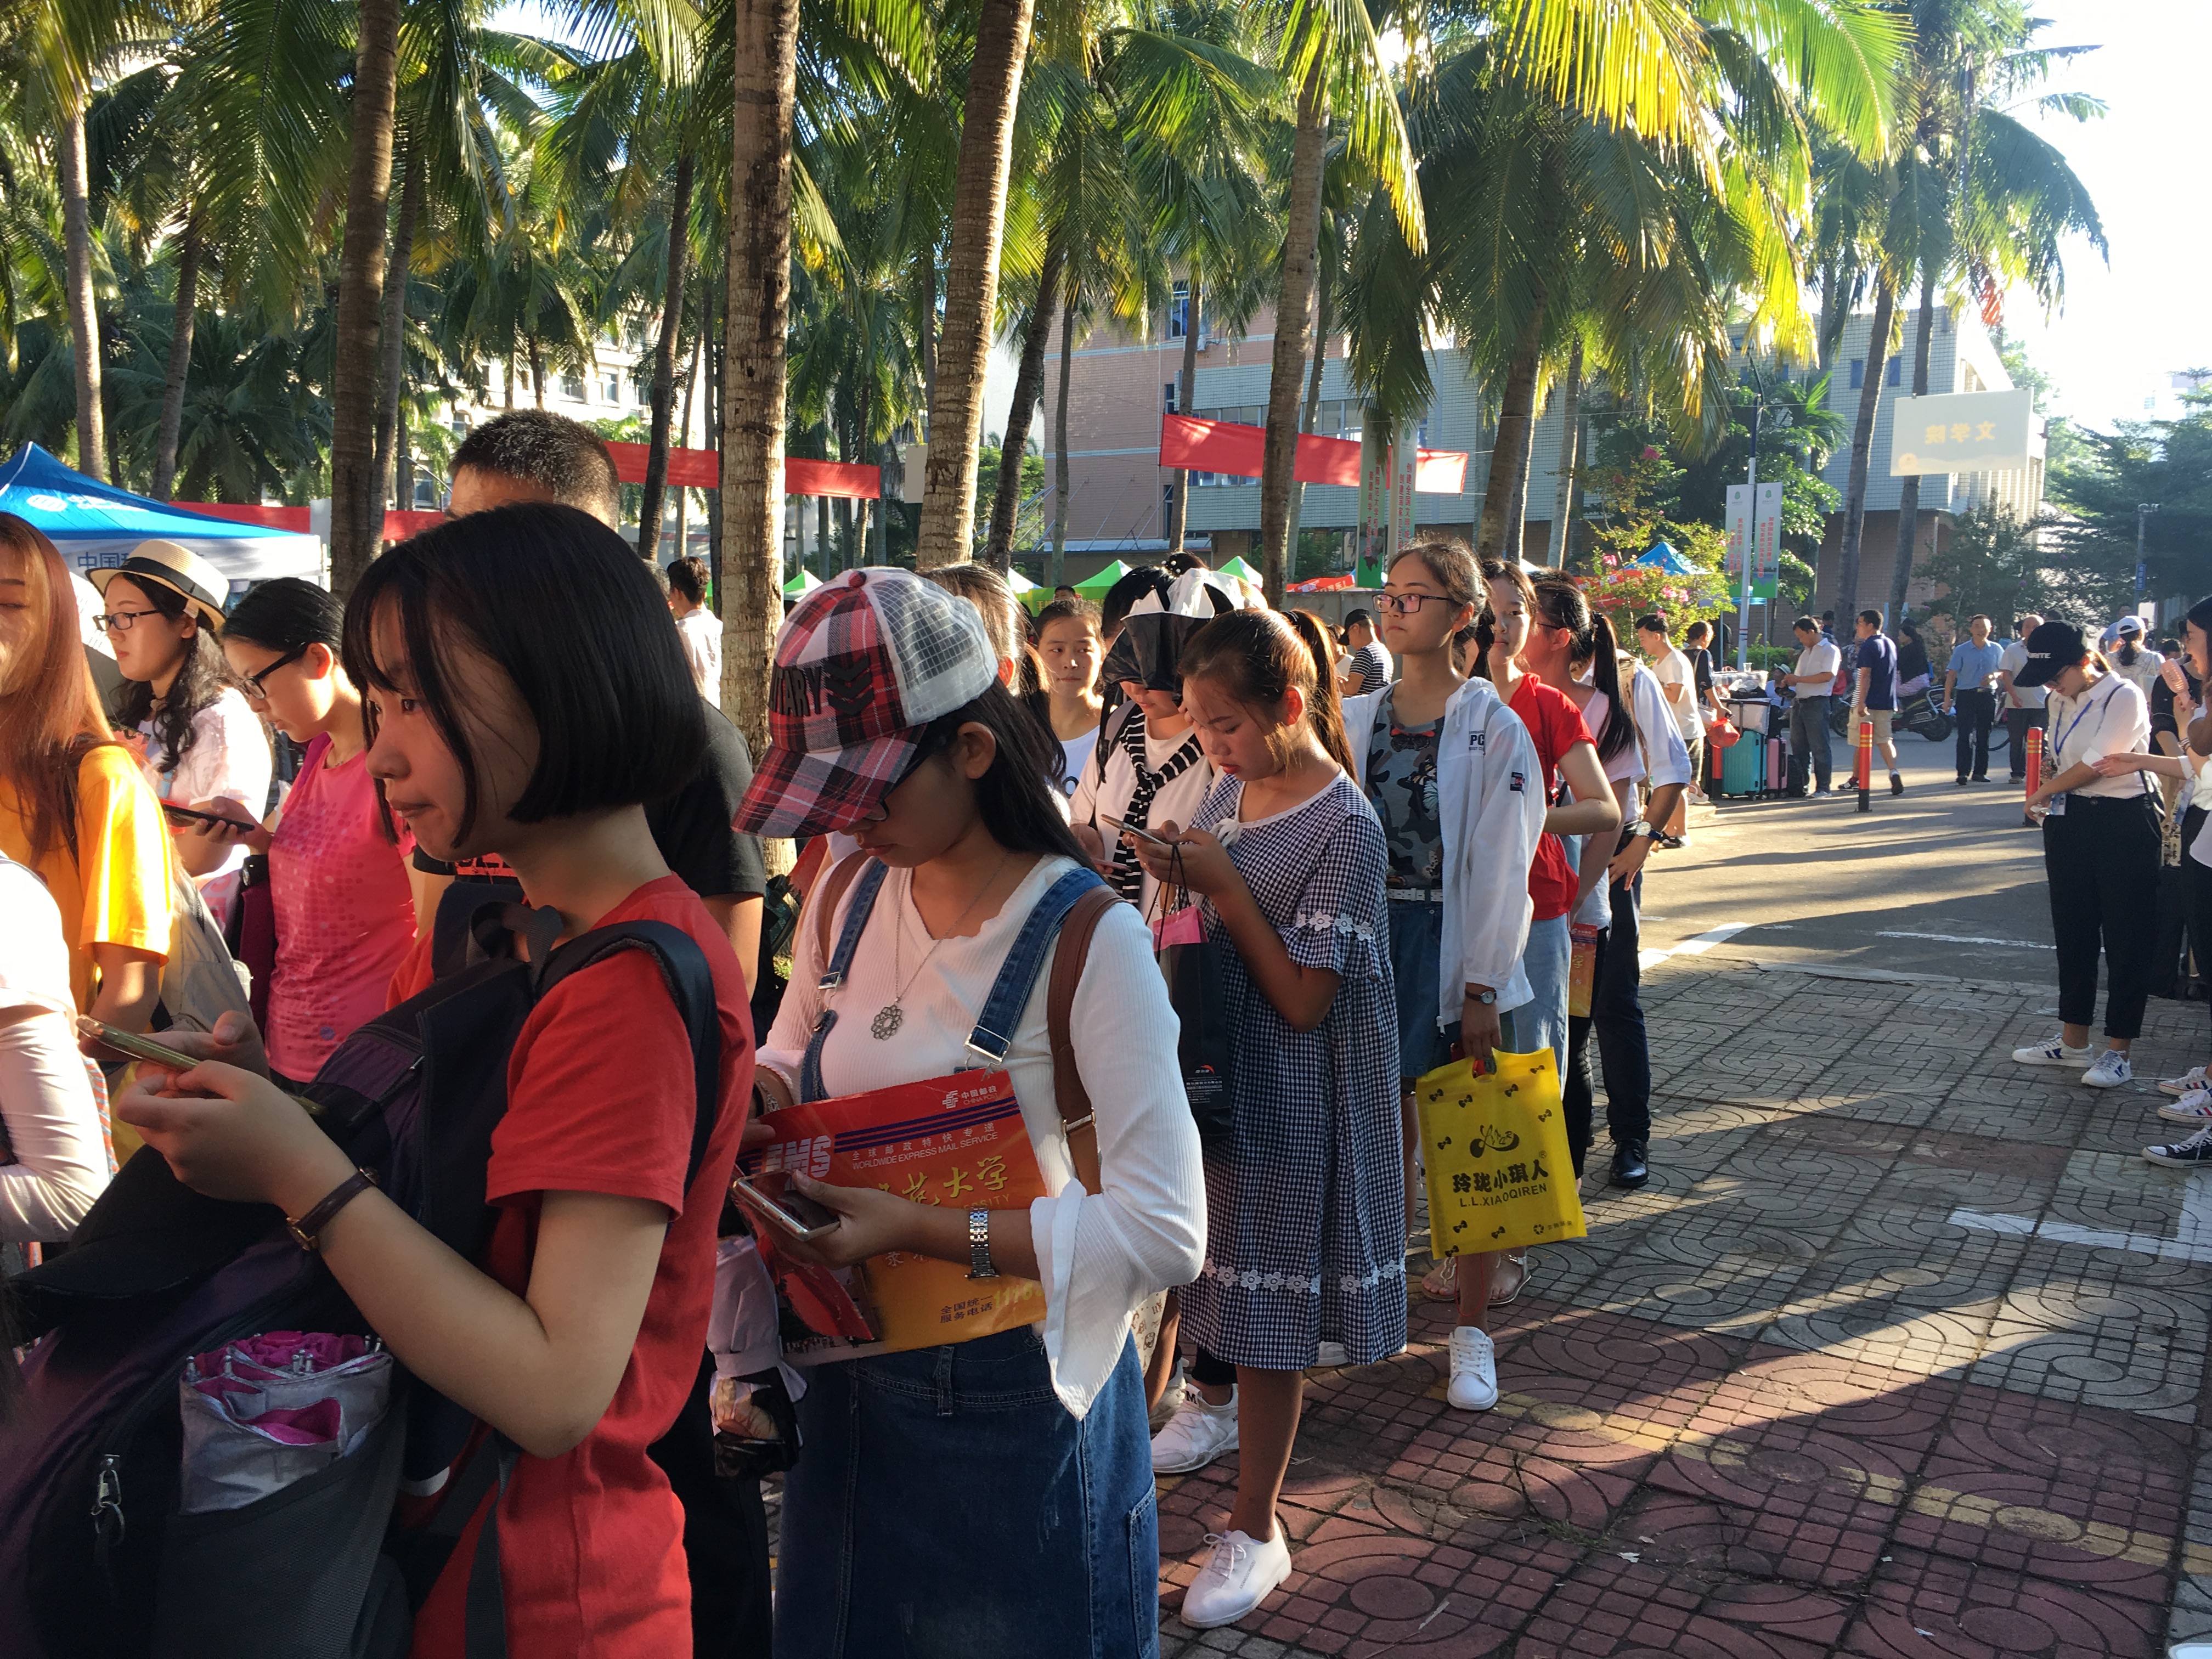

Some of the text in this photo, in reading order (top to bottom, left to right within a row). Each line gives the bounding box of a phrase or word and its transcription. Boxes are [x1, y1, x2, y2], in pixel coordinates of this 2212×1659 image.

[961, 1086, 997, 1099] 中国邮政
[963, 1097, 983, 1105] CHINA
[853, 1122, 995, 1161] 全球邮政特快专递
[853, 1132, 998, 1170] WORLDWIDE EXPRESS MAIL SERVICE
[1453, 1159, 1549, 1193] 玲珑小琪人
[940, 1302, 993, 1323] 服务电话
[941, 1295, 993, 1314] 全国统一
